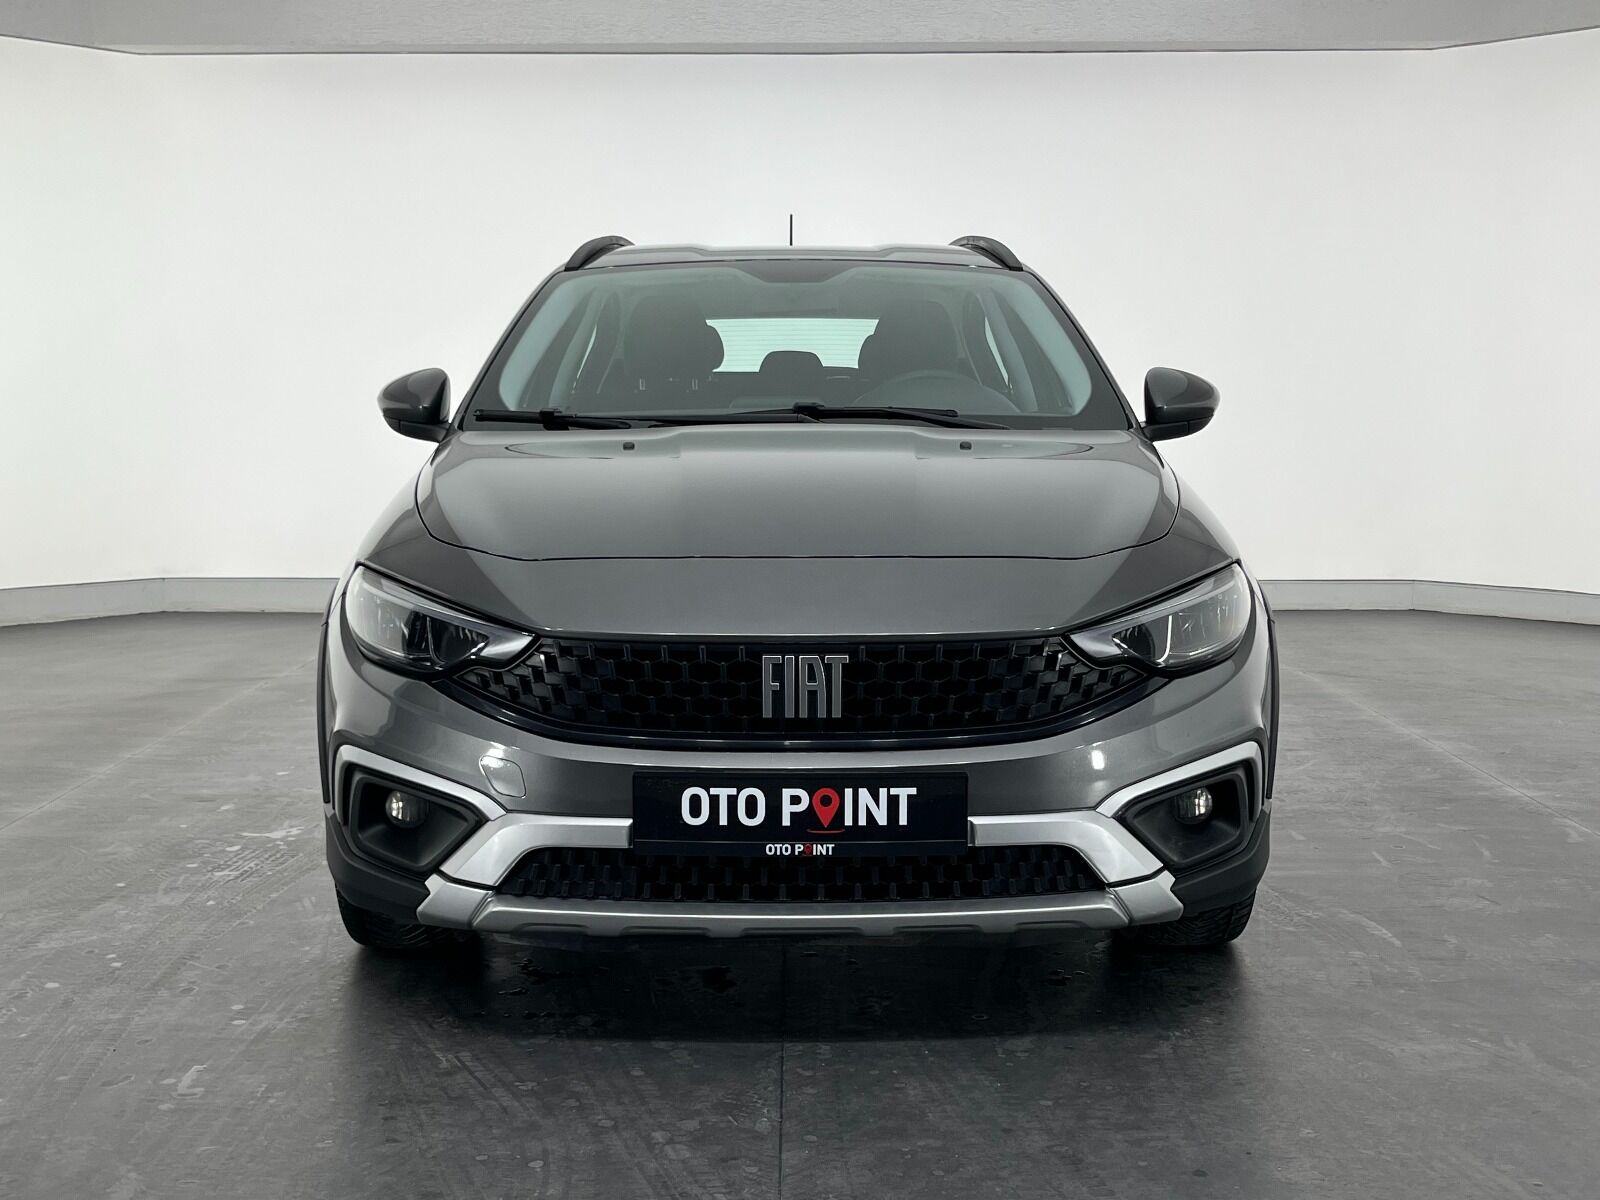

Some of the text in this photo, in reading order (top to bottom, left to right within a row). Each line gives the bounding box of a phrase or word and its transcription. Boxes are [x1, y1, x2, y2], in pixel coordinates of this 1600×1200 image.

[762, 655, 849, 719] FIAT
[681, 787, 918, 828] OTO POINT
[765, 843, 835, 857] OTO POINT
